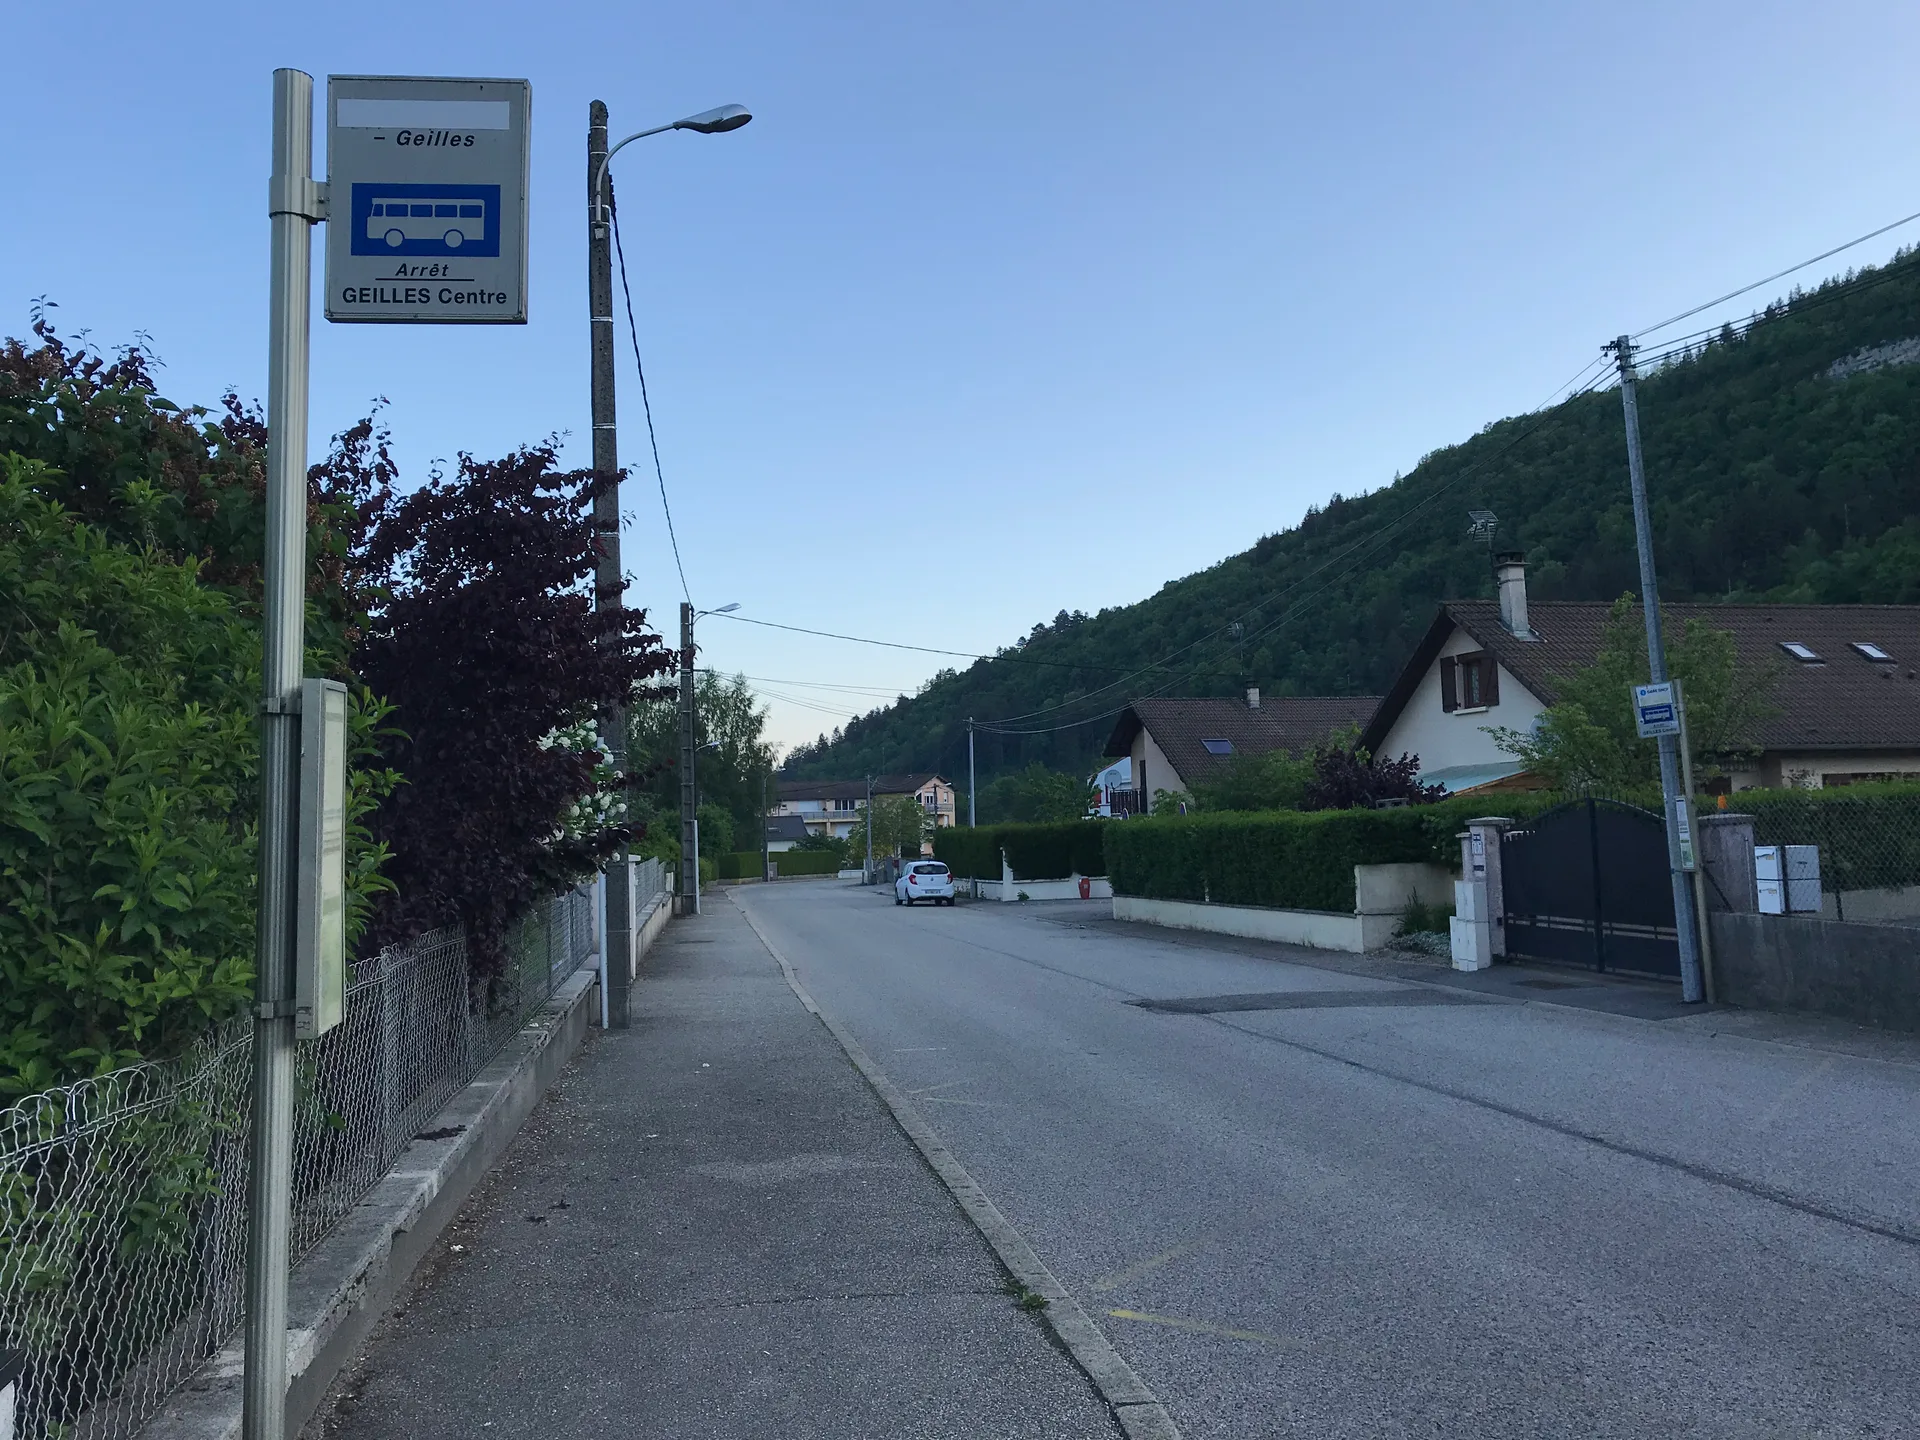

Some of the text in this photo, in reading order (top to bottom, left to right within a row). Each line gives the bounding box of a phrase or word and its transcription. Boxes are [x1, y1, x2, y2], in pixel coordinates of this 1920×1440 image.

[396, 130, 476, 147] Geilles
[395, 263, 450, 277] Arrêt
[342, 287, 507, 305] GEILLES Centre
